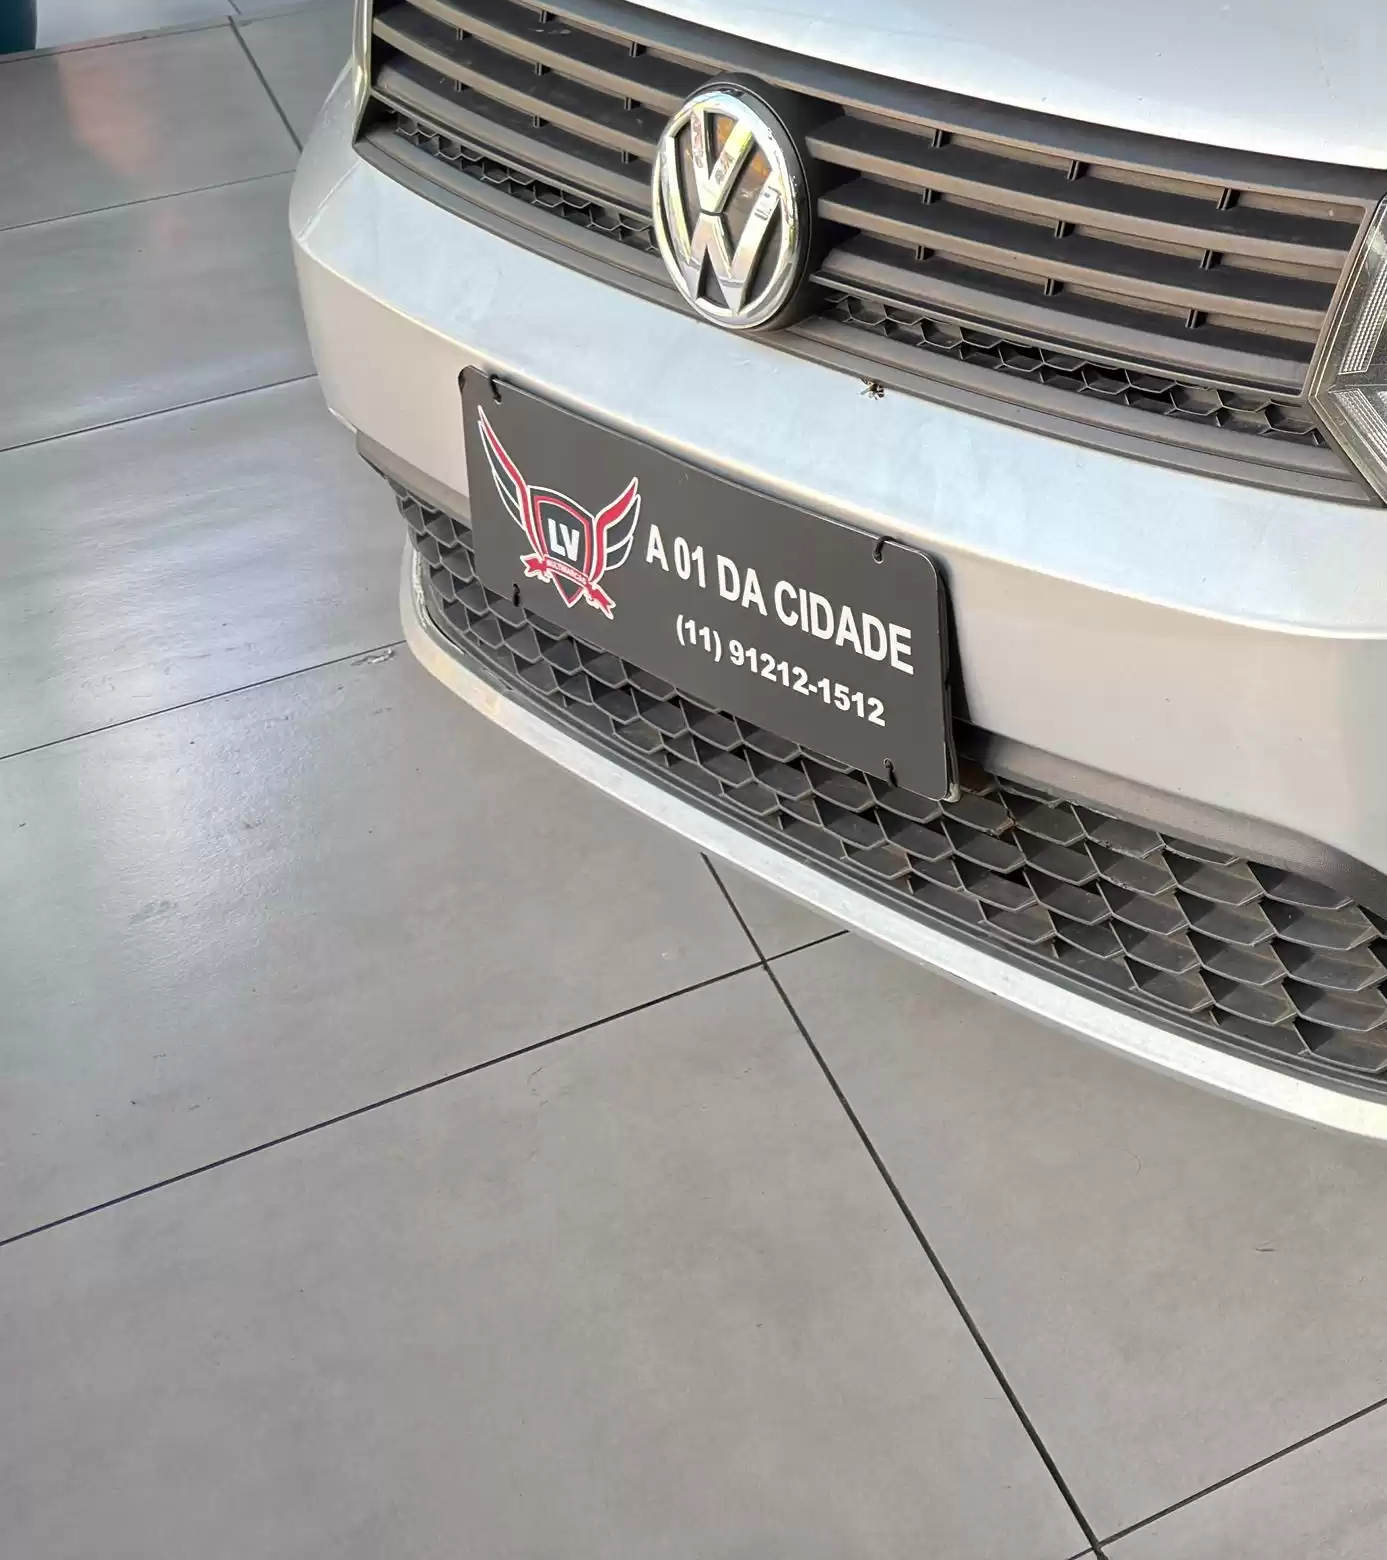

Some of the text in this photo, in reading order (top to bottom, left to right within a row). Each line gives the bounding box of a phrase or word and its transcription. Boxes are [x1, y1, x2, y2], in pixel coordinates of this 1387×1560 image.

[548, 518, 580, 562] LV
[646, 524, 914, 675] A 01 DA CIDADE
[676, 614, 886, 727] (11) 91212-1512
